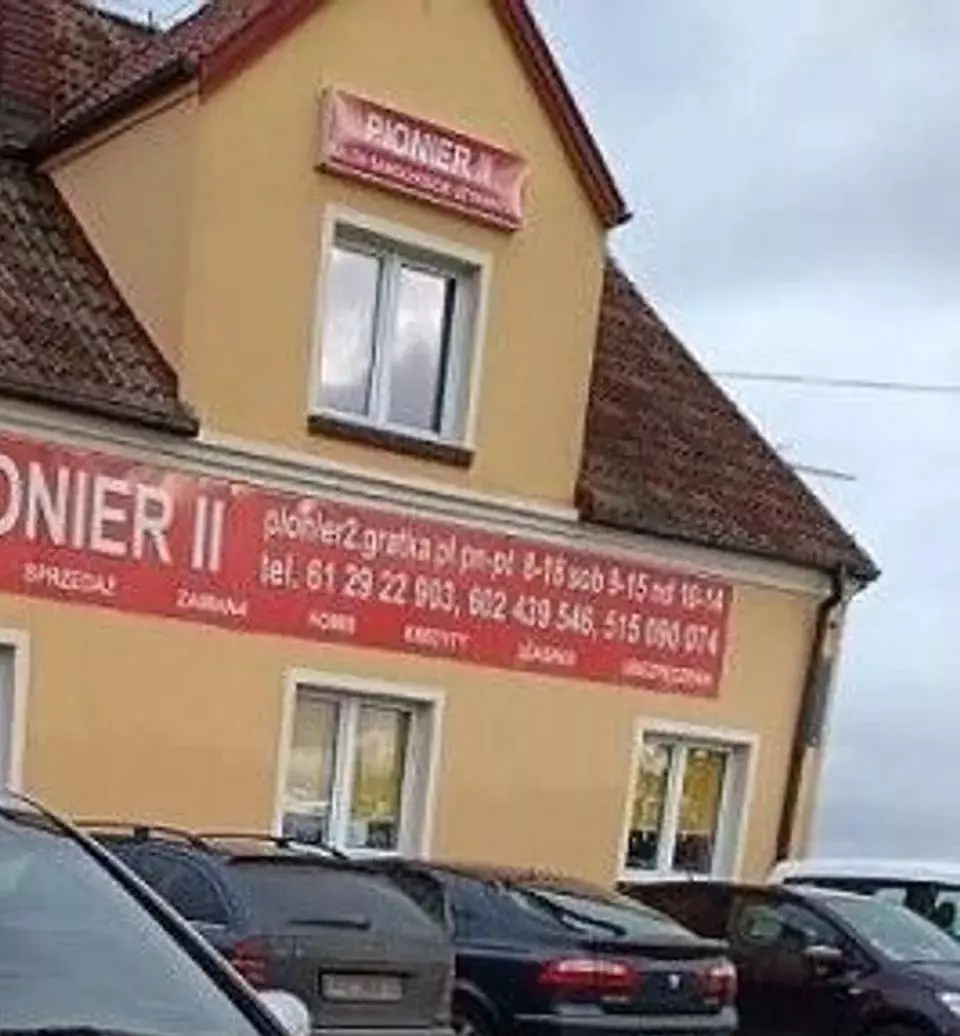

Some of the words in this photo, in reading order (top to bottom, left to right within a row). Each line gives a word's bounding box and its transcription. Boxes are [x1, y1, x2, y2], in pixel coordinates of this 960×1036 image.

[191, 497, 225, 573] II
[306, 558, 336, 592] 61
[379, 569, 407, 605] 22
